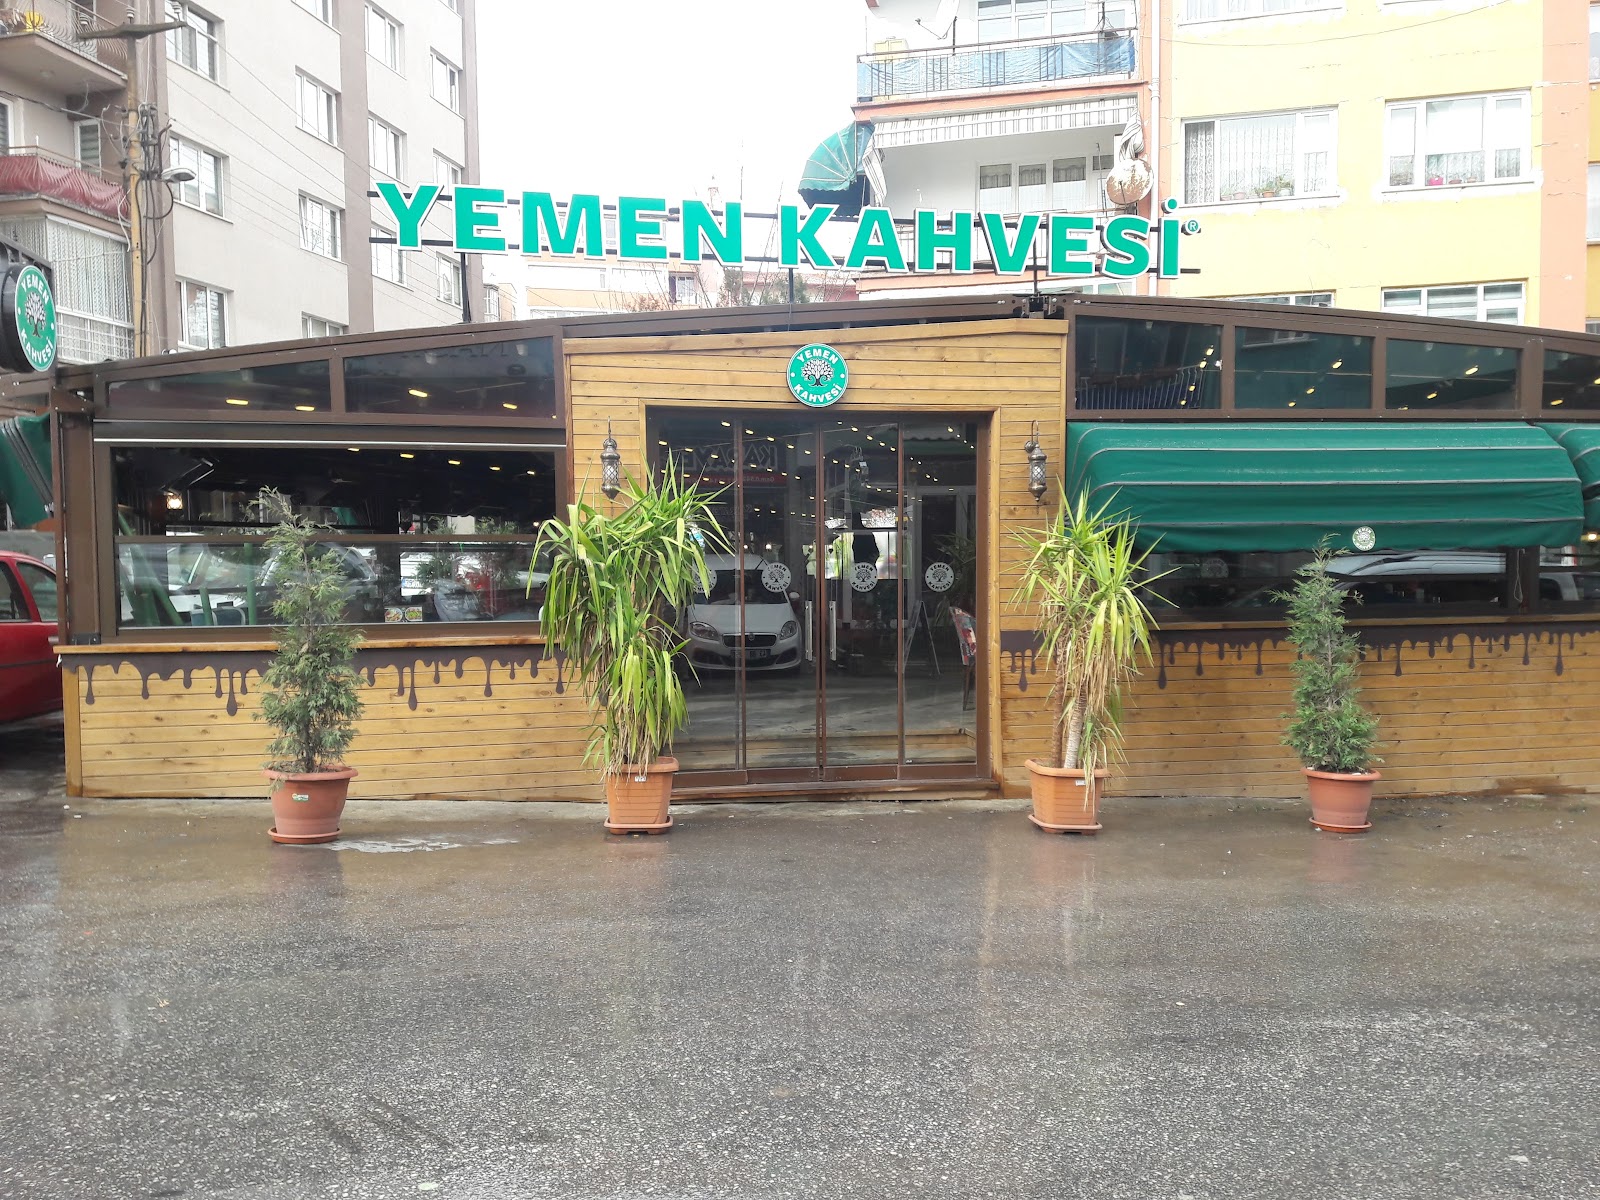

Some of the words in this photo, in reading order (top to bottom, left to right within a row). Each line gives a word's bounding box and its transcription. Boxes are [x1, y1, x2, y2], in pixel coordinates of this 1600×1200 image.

[375, 182, 742, 264] YEMEN
[778, 198, 1179, 277] KAHVESİ
[21, 274, 49, 304] YEMEN
[20, 328, 54, 364] KAHVESİ
[796, 348, 839, 365] YEMEN
[793, 383, 843, 403] KAHVESİ
[854, 564, 874, 572] YEMEN
[930, 564, 950, 572] YEMEN
